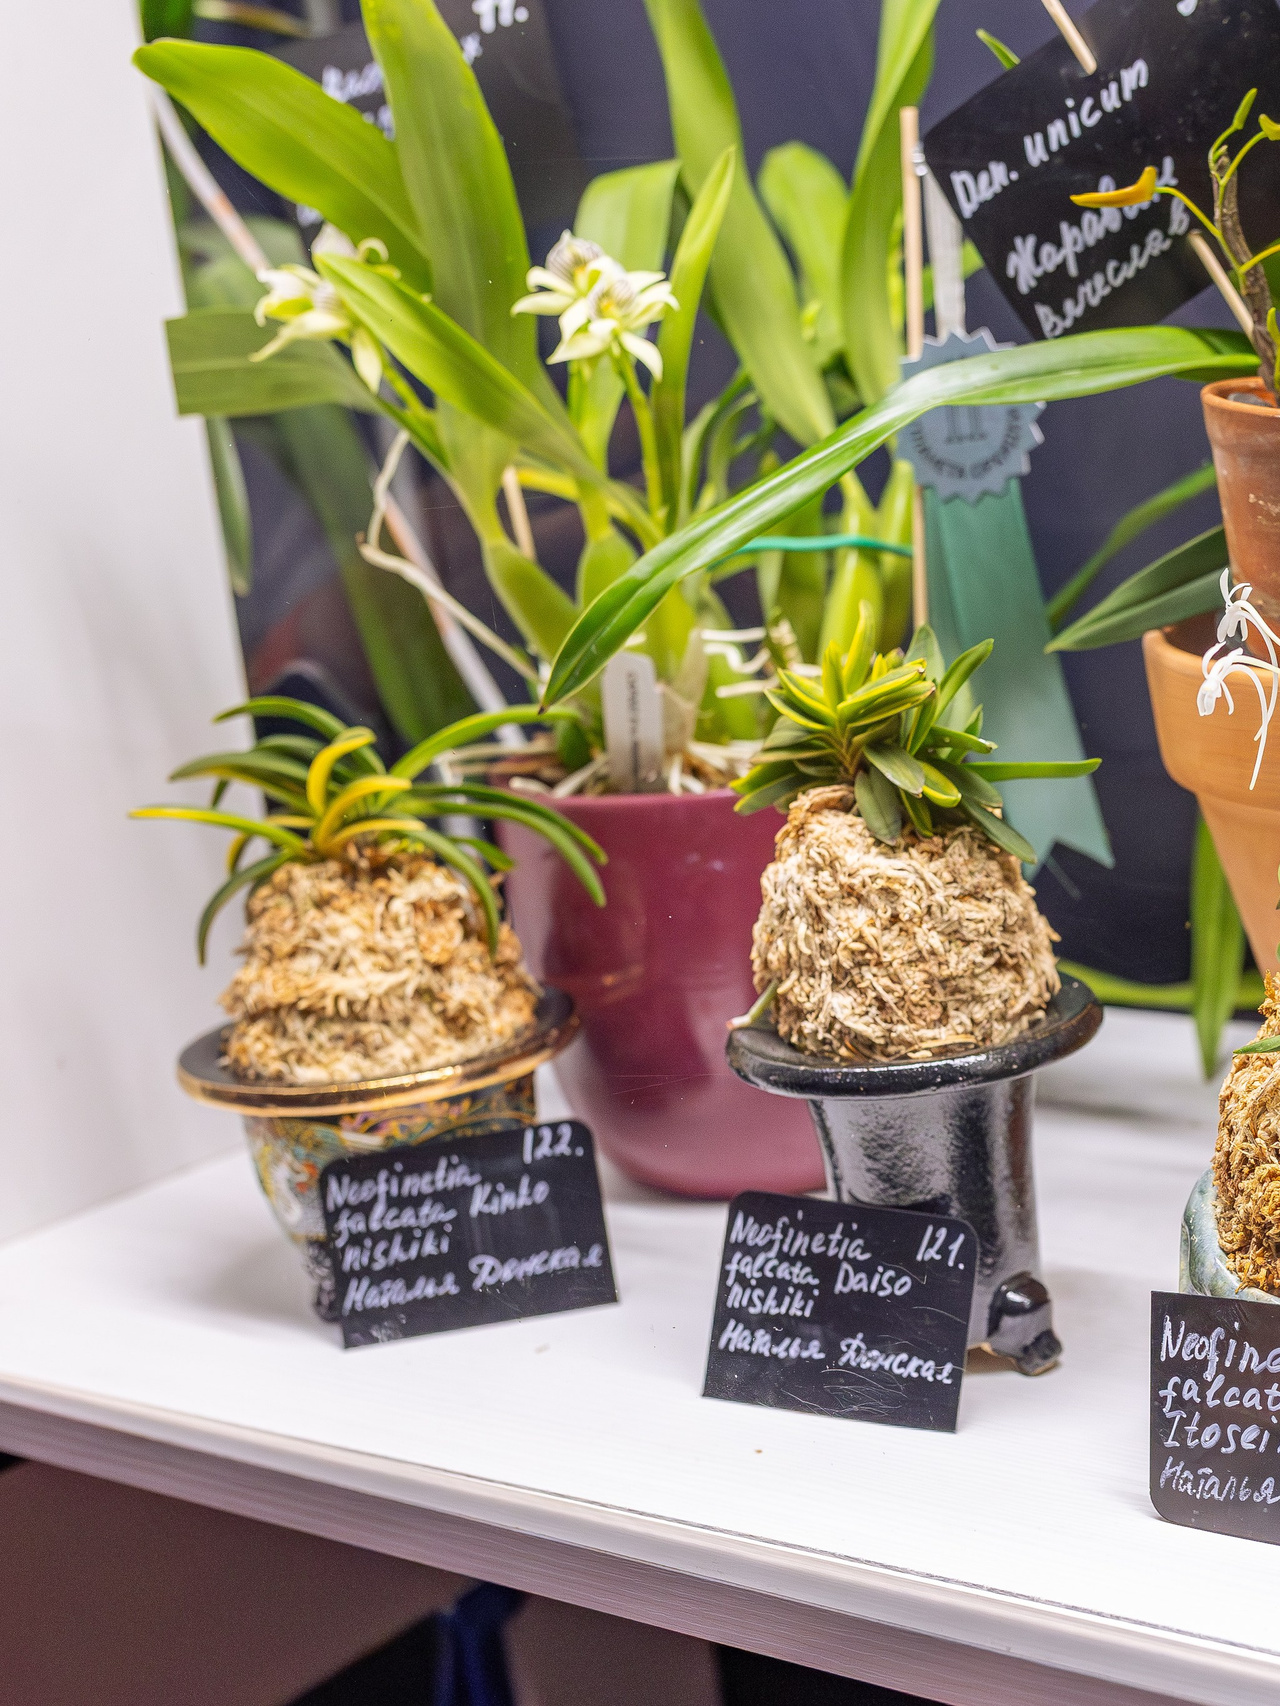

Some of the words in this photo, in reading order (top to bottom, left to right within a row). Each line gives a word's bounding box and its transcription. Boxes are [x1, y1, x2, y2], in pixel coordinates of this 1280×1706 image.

[1023, 58, 1149, 168] unicum
[522, 1122, 585, 1164] 122.
[326, 1154, 482, 1212] Neofinetia
[334, 1199, 458, 1248] falcata
[469, 1174, 550, 1218] Kinko
[729, 1209, 872, 1260] Neofinetia
[341, 1222, 453, 1273] nishiki
[915, 1224, 966, 1271] 121.
[341, 1271, 460, 1316] Наталья
[468, 1243, 603, 1291] Донская
[725, 1251, 820, 1287] falcata
[834, 1261, 912, 1297] Daiso
[726, 1277, 820, 1318] nishiki
[718, 1318, 826, 1359] Наталья
[839, 1332, 953, 1384] Донская
